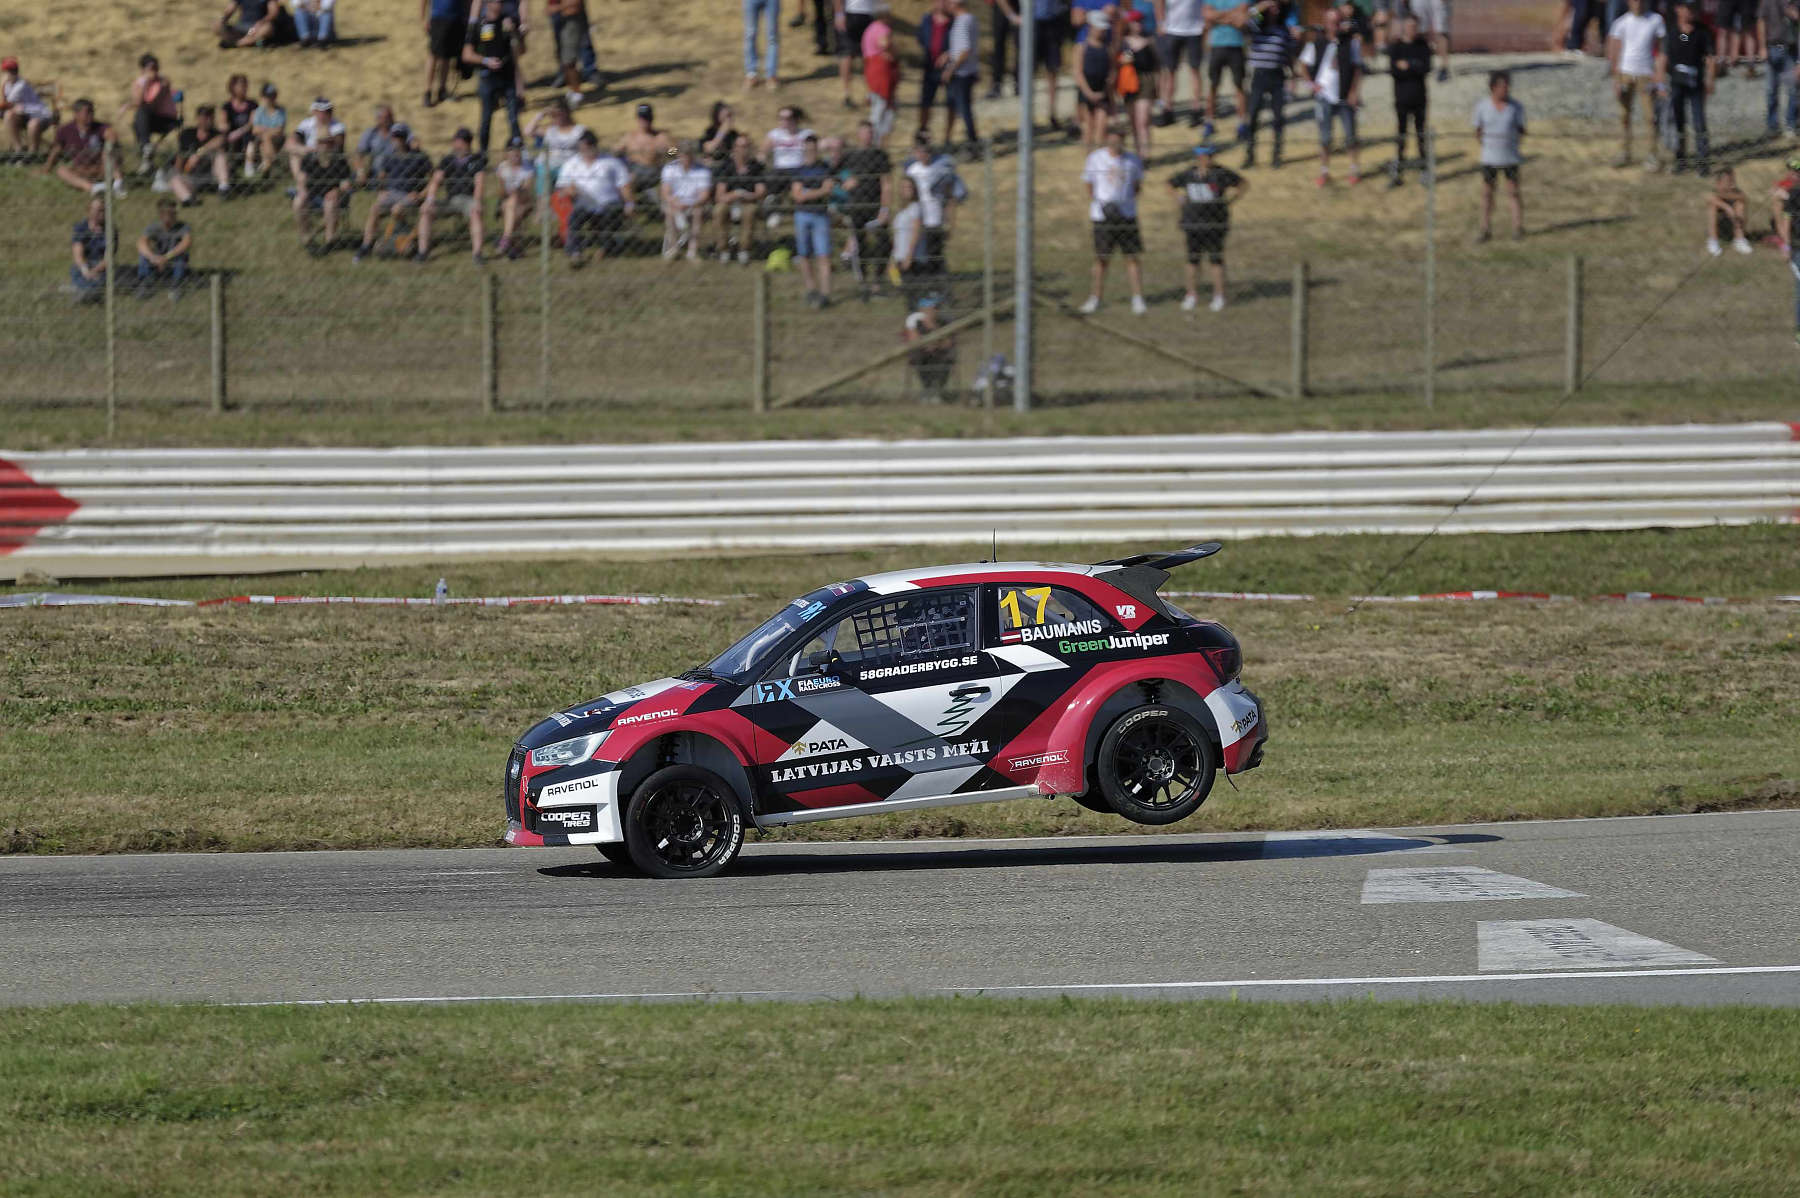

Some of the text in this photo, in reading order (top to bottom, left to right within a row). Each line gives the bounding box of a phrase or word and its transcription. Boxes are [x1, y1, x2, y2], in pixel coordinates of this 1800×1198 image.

[1000, 586, 1052, 629] 17
[1020, 618, 1103, 643] BAUMANIS
[1058, 632, 1170, 654] GreenJuniper
[859, 655, 979, 681] 58GRADERBYGG.SE
[798, 681, 841, 693] RALLYCROSS
[617, 708, 680, 726] RAVENOL
[1117, 709, 1169, 734] COOPER
[1242, 709, 1257, 728] PATA
[808, 738, 849, 754] PATA
[770, 739, 990, 783] LATVIJAS VALSTS MEŽI
[1014, 754, 1064, 768] RAVENOL
[547, 779, 599, 797] RAVENOL
[540, 811, 591, 822] COOPER
[562, 820, 591, 828] TIRES
[717, 814, 740, 866] COOPER
